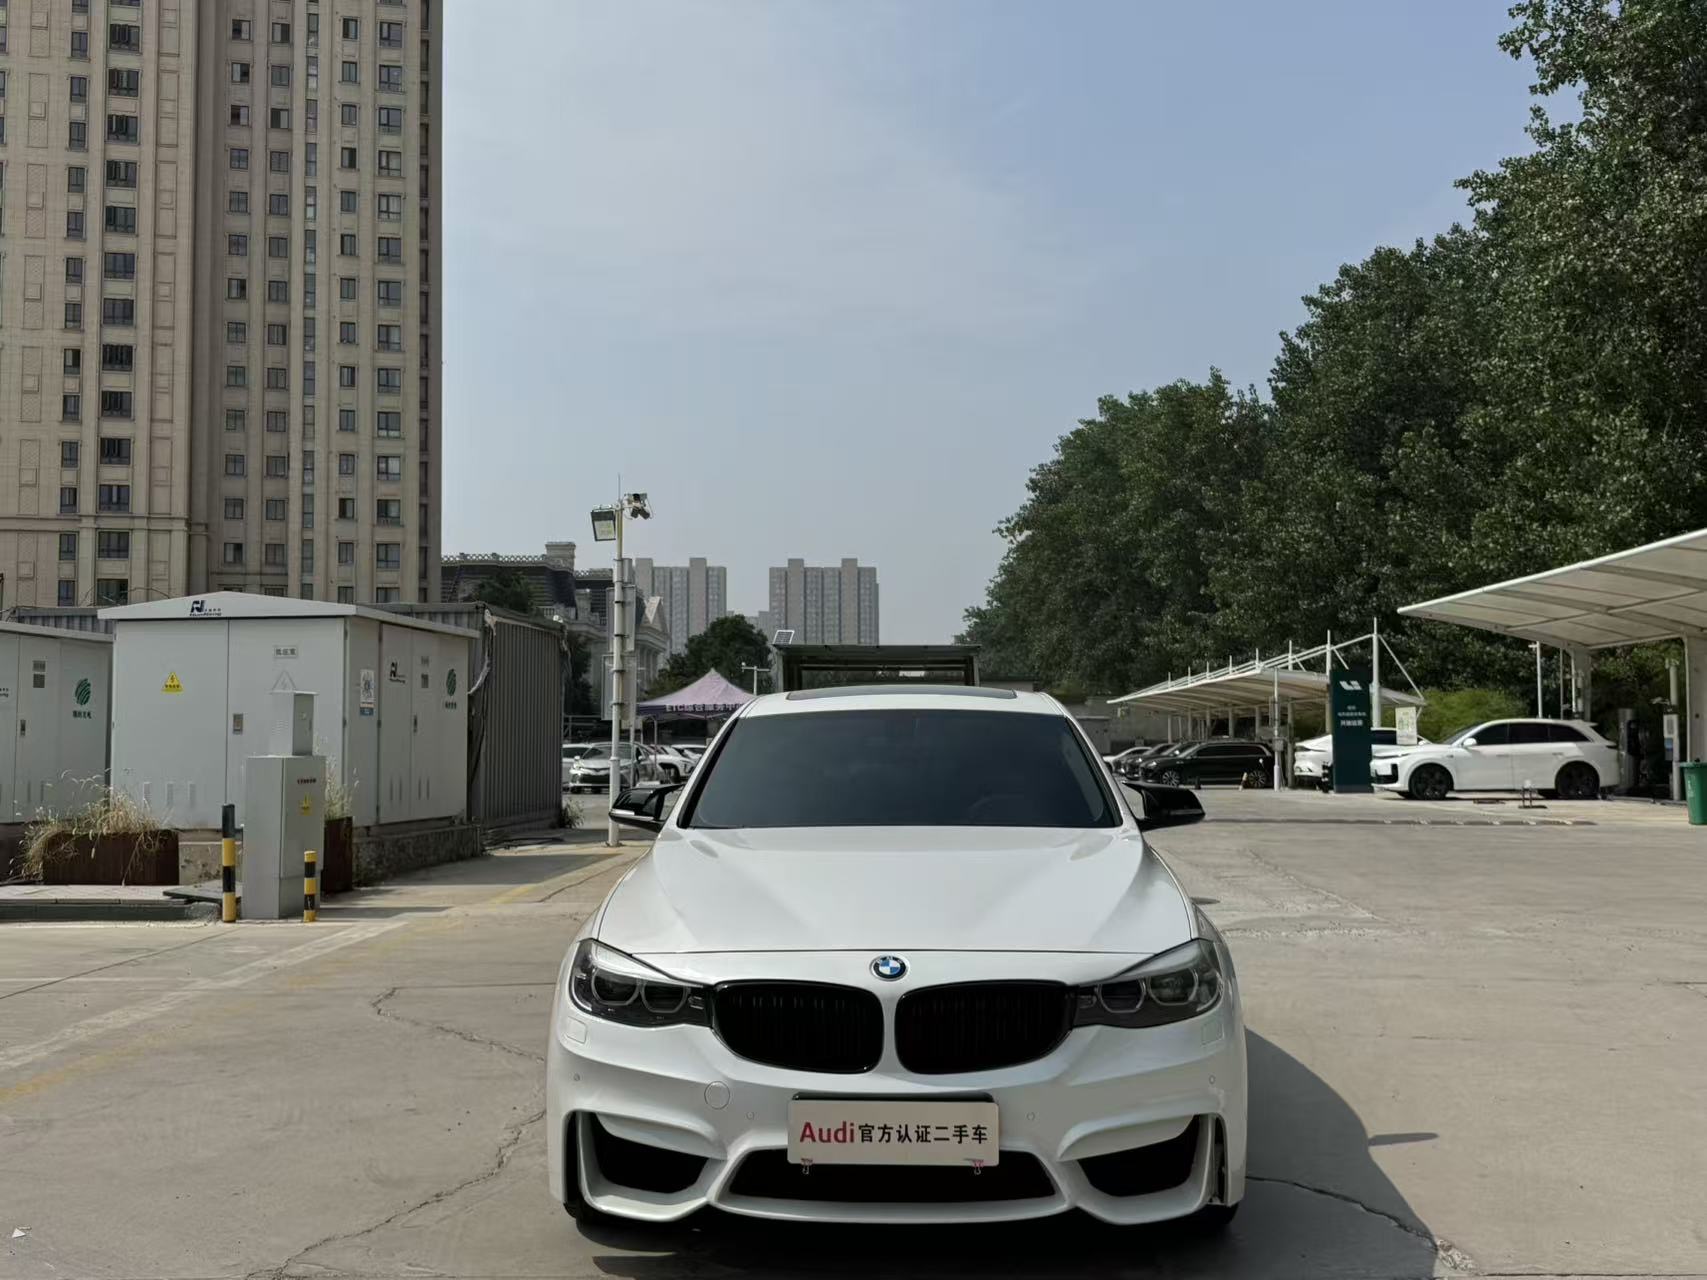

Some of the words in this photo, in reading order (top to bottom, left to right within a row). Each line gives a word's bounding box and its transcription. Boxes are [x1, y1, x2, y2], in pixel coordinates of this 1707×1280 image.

[799, 1121, 855, 1143] Audi
[858, 1123, 988, 1145] 官方认证二手车
